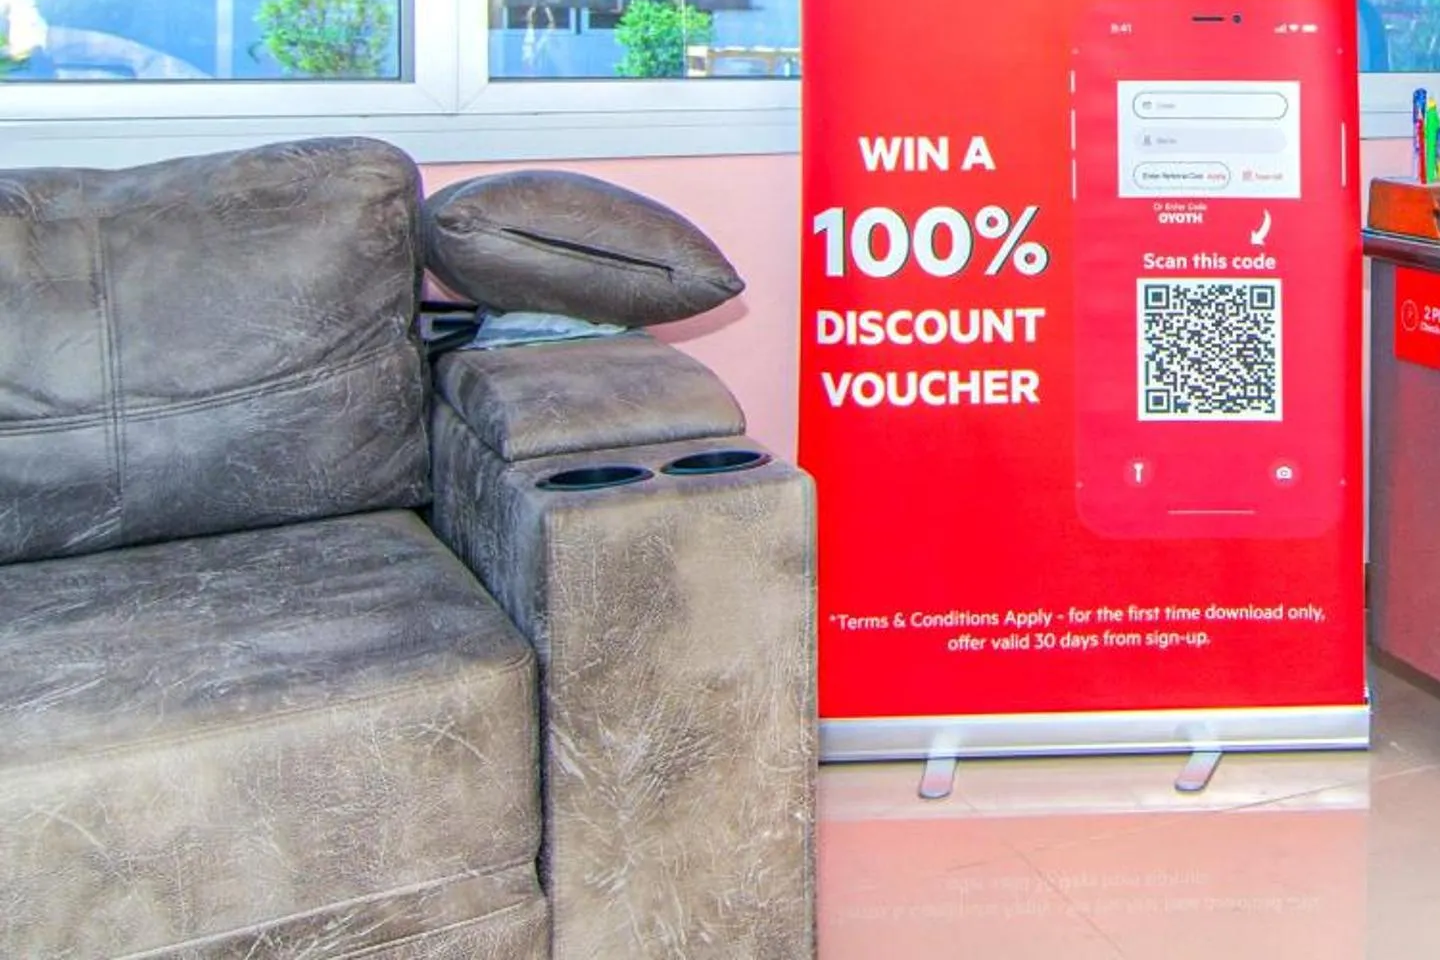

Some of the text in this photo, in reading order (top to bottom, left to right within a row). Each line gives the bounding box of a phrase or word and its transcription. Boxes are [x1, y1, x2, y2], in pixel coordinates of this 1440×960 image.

[858, 135, 997, 172] WIN A
[812, 204, 1051, 278] 100%
[1143, 252, 1276, 270] Scan this code
[815, 307, 1046, 346] DISCOUNT
[820, 368, 1041, 408] VOUCHER
[893, 612, 906, 629] &
[910, 609, 1000, 629] Conditions
[1003, 608, 1052, 630] Apply
[1068, 606, 1092, 624] for
[1096, 606, 1124, 623] the
[1127, 605, 1160, 623] first
[1164, 604, 1201, 622] time
[1204, 603, 1284, 621] download
[947, 629, 1211, 652] offer valid 30 days from sign-up.
